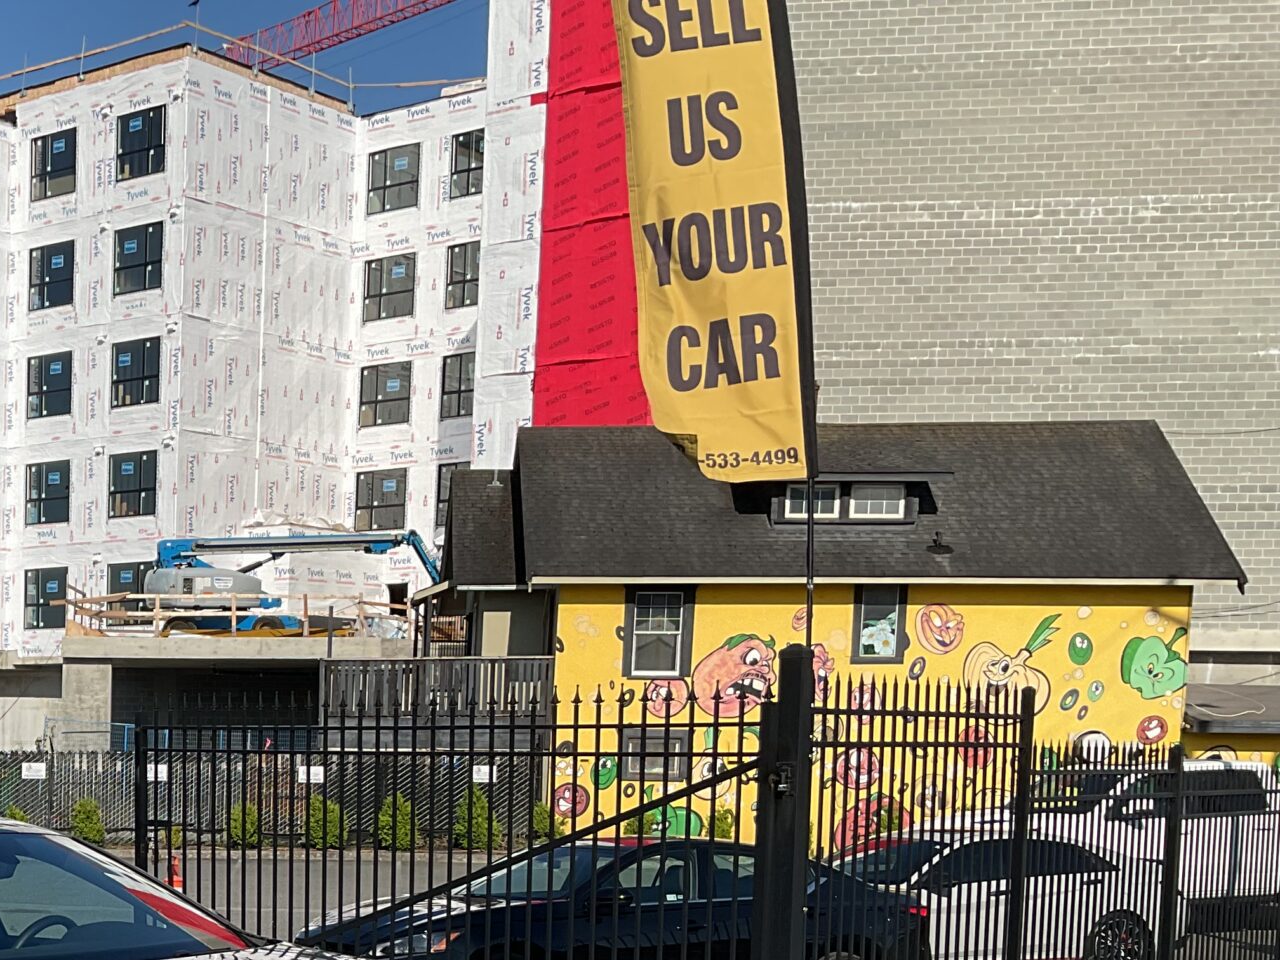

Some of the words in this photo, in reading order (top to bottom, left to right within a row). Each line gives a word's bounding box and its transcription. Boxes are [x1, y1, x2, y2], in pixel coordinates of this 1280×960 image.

[628, 0, 762, 58] SELL
[532, 58, 544, 87] Tyve
[213, 86, 233, 100] Tyvek
[250, 83, 267, 97] Tyvek
[129, 96, 152, 109] Tyvek
[280, 93, 297, 107] Tyvek
[448, 95, 472, 109] Tyvek
[308, 104, 325, 118] Tyvek
[407, 105, 431, 118] Tyvek
[56, 116, 77, 129] Tyvek
[336, 113, 353, 128] Tyvek
[367, 115, 390, 127] Tyvek
[21, 126, 42, 138] Tyvek
[666, 91, 742, 166] US
[528, 149, 539, 186] Tyvek
[127, 187, 149, 201] Tyvek
[30, 211, 48, 222] yvek
[62, 207, 77, 216] Tyve
[468, 223, 480, 234] Tyv
[527, 211, 537, 240] Tyve
[294, 231, 311, 243] Tyvek
[427, 229, 451, 241] Tyvek
[322, 238, 339, 250] Tyvek
[386, 237, 410, 248] Tyvek
[642, 202, 787, 287] YOUR
[523, 285, 533, 320] Tyvek
[278, 336, 294, 347] Tyvek
[447, 335, 471, 348] Tyvek
[306, 343, 323, 354] Tyvek
[367, 347, 389, 358] Tyvek
[406, 342, 430, 354] Tyvek
[666, 313, 781, 392] CAR
[520, 346, 530, 374] Tyve
[476, 421, 487, 457] Tyvek
[265, 443, 282, 454] Tyvek
[294, 447, 310, 459] Tyvek
[430, 446, 455, 457] Tyvek
[351, 454, 374, 464] Tyvek
[390, 450, 414, 460] Tyvek
[389, 557, 412, 567] Tyvek
[274, 567, 296, 577] Tyvek
[308, 568, 324, 577] Tyvek
[336, 570, 352, 579] Tyvek
